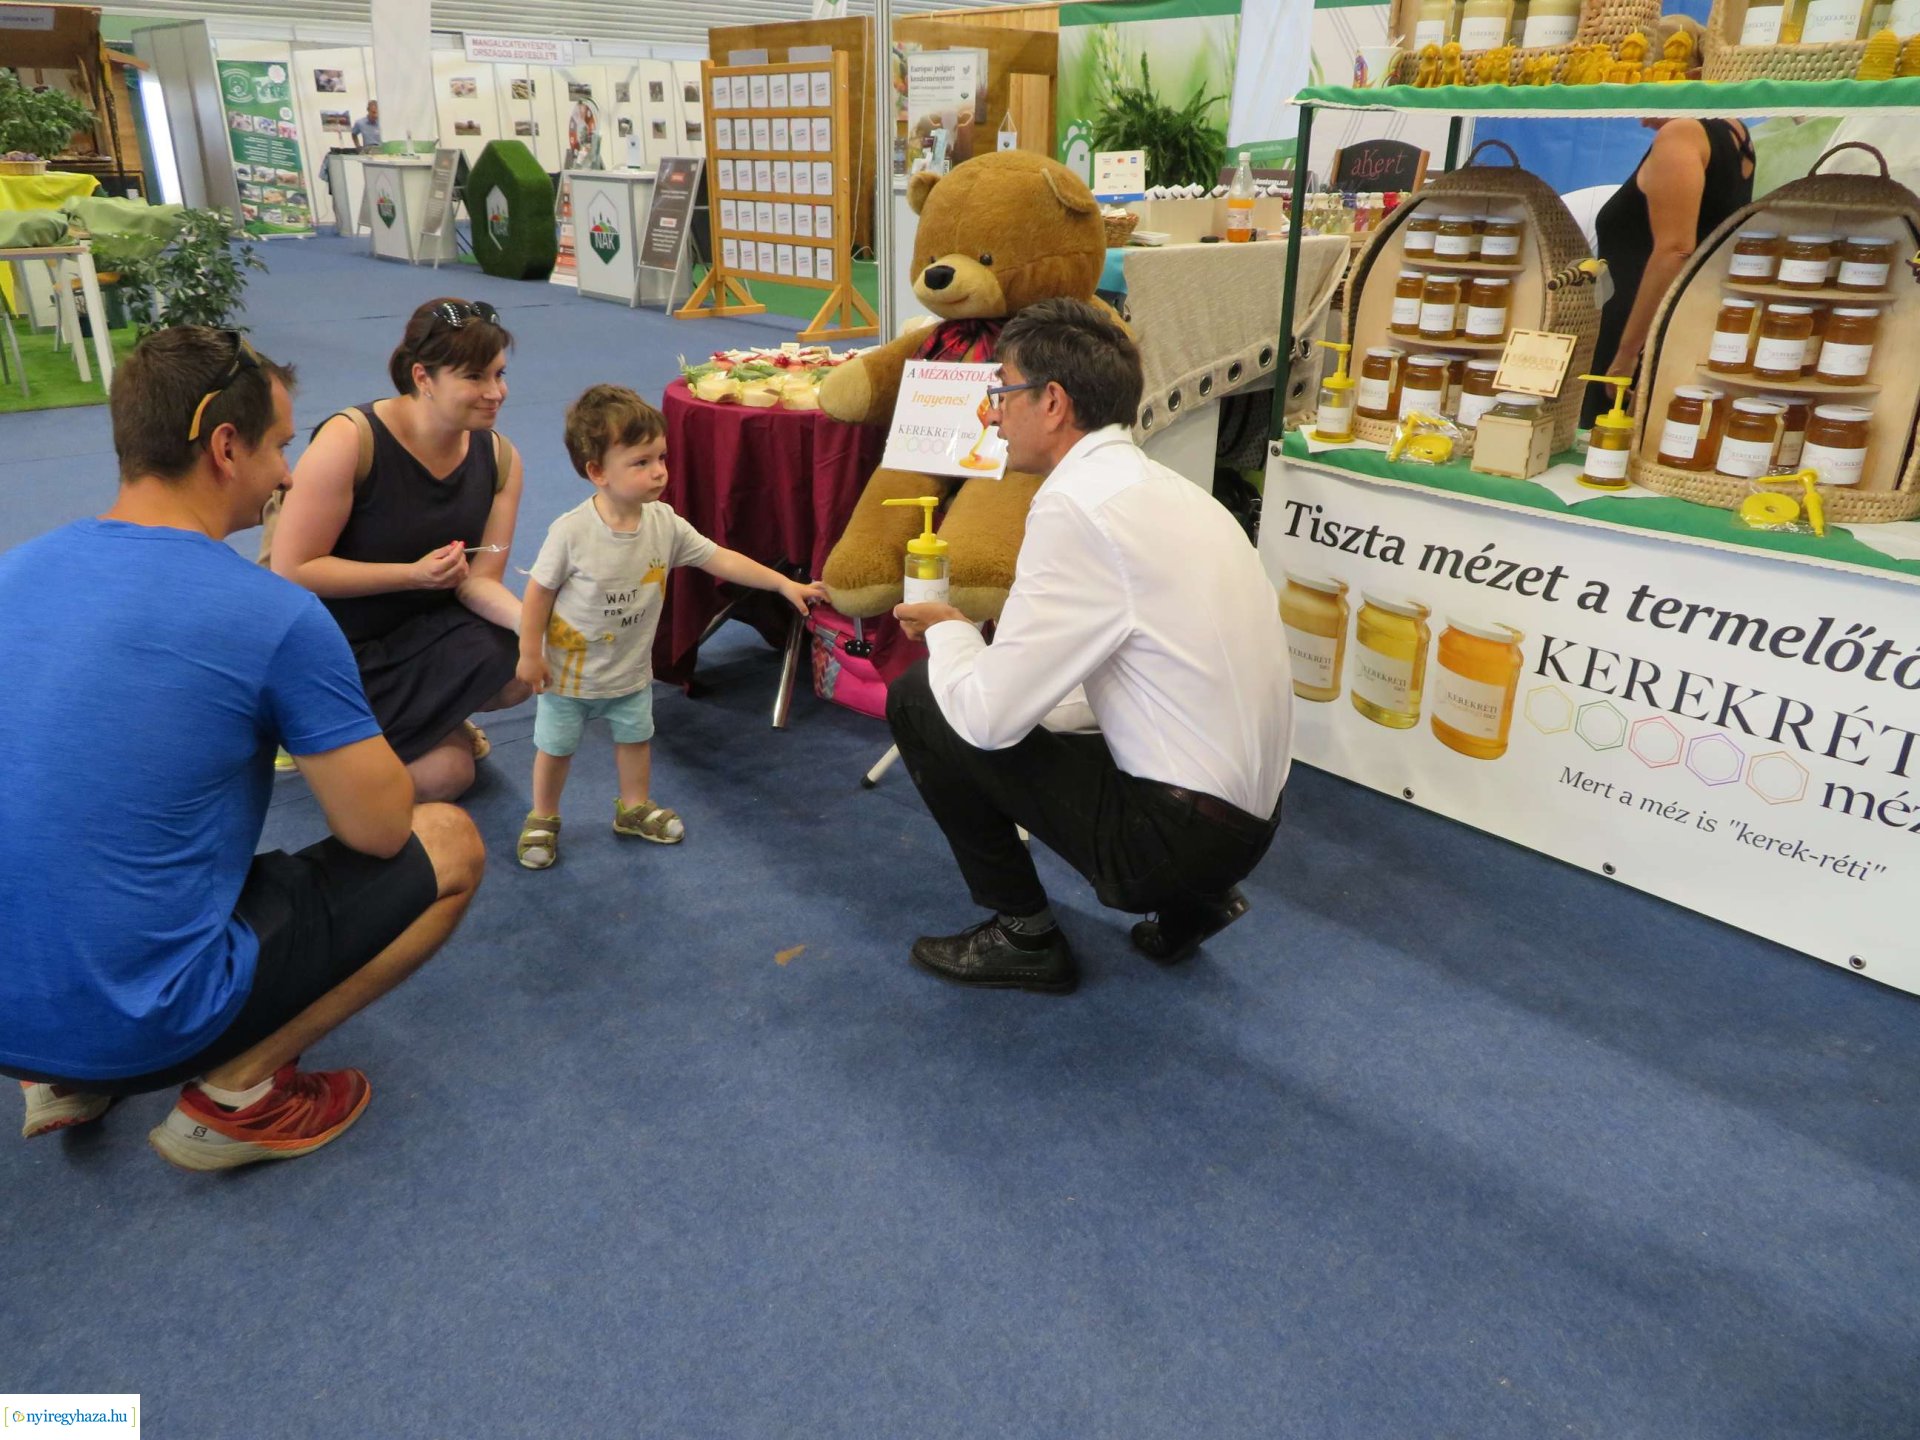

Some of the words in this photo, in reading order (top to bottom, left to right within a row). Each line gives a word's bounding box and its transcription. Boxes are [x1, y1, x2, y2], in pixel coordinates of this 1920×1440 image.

[594, 233, 615, 250] NAK
[907, 368, 917, 378] A
[911, 391, 971, 408] Ingyenes!
[1284, 500, 1405, 566] Tiszta
[1418, 542, 1569, 602] mézet
[1577, 580, 1610, 613] a
[605, 589, 638, 604] WAIT
[1534, 634, 1920, 778] KEREKRÉT
[1558, 766, 1614, 799] Mert
[1618, 790, 1633, 807] a
[1639, 795, 1690, 825] méz
[1695, 810, 1718, 833] is
[1729, 818, 1888, 882] "kerek-réti"
